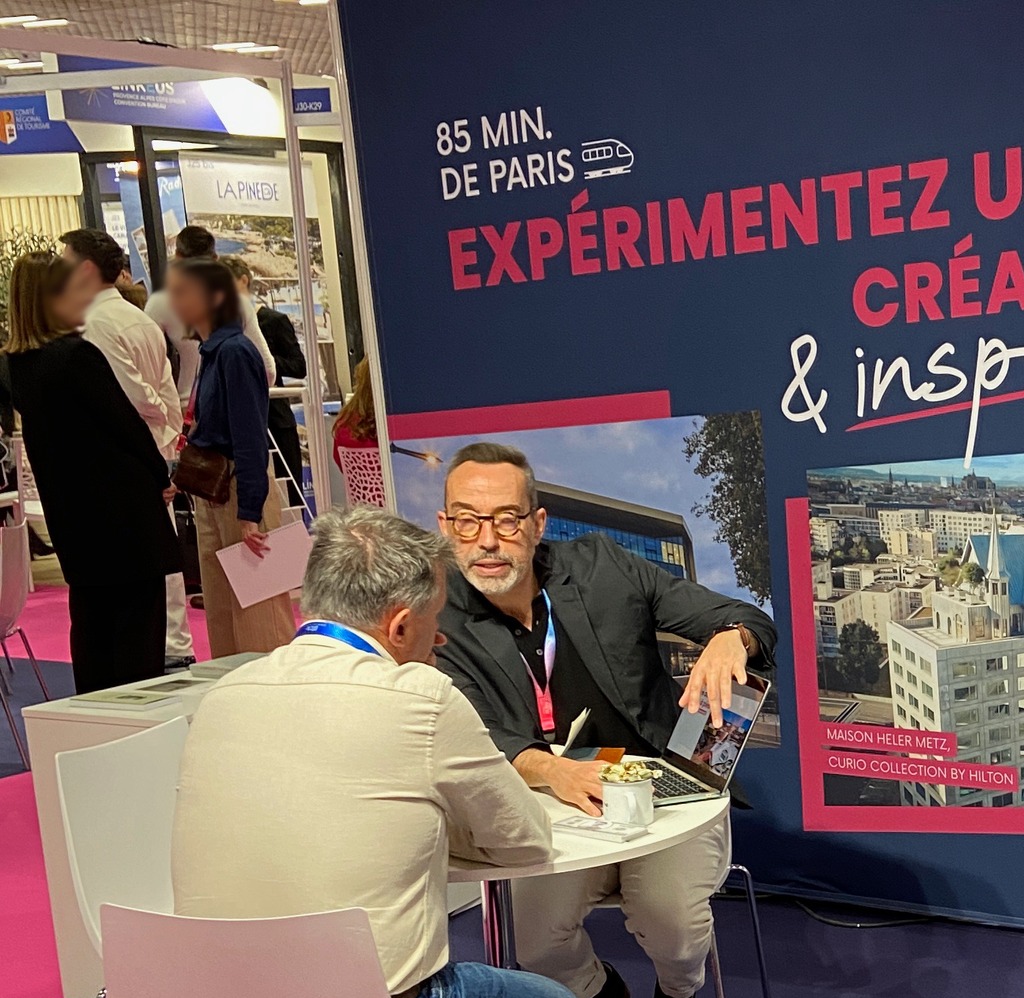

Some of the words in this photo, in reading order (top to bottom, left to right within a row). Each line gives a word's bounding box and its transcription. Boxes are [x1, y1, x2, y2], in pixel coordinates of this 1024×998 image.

[296, 101, 322, 111] J30-K29
[436, 119, 472, 156] 85
[480, 106, 553, 149] MIN.
[217, 180, 237, 199] LA
[440, 163, 481, 201] DE
[489, 148, 575, 193] PARIS
[448, 159, 950, 290] EXPÉRIMENTEZ
[781, 334, 827, 433] &
[827, 728, 873, 744] MAISON
[877, 733, 912, 747] HELER
[915, 736, 951, 752] METZ,
[828, 756, 867, 771] CURIO
[870, 760, 947, 779] COLLECTION
[951, 767, 966, 780] BY
[969, 769, 1014, 786] HILTON
